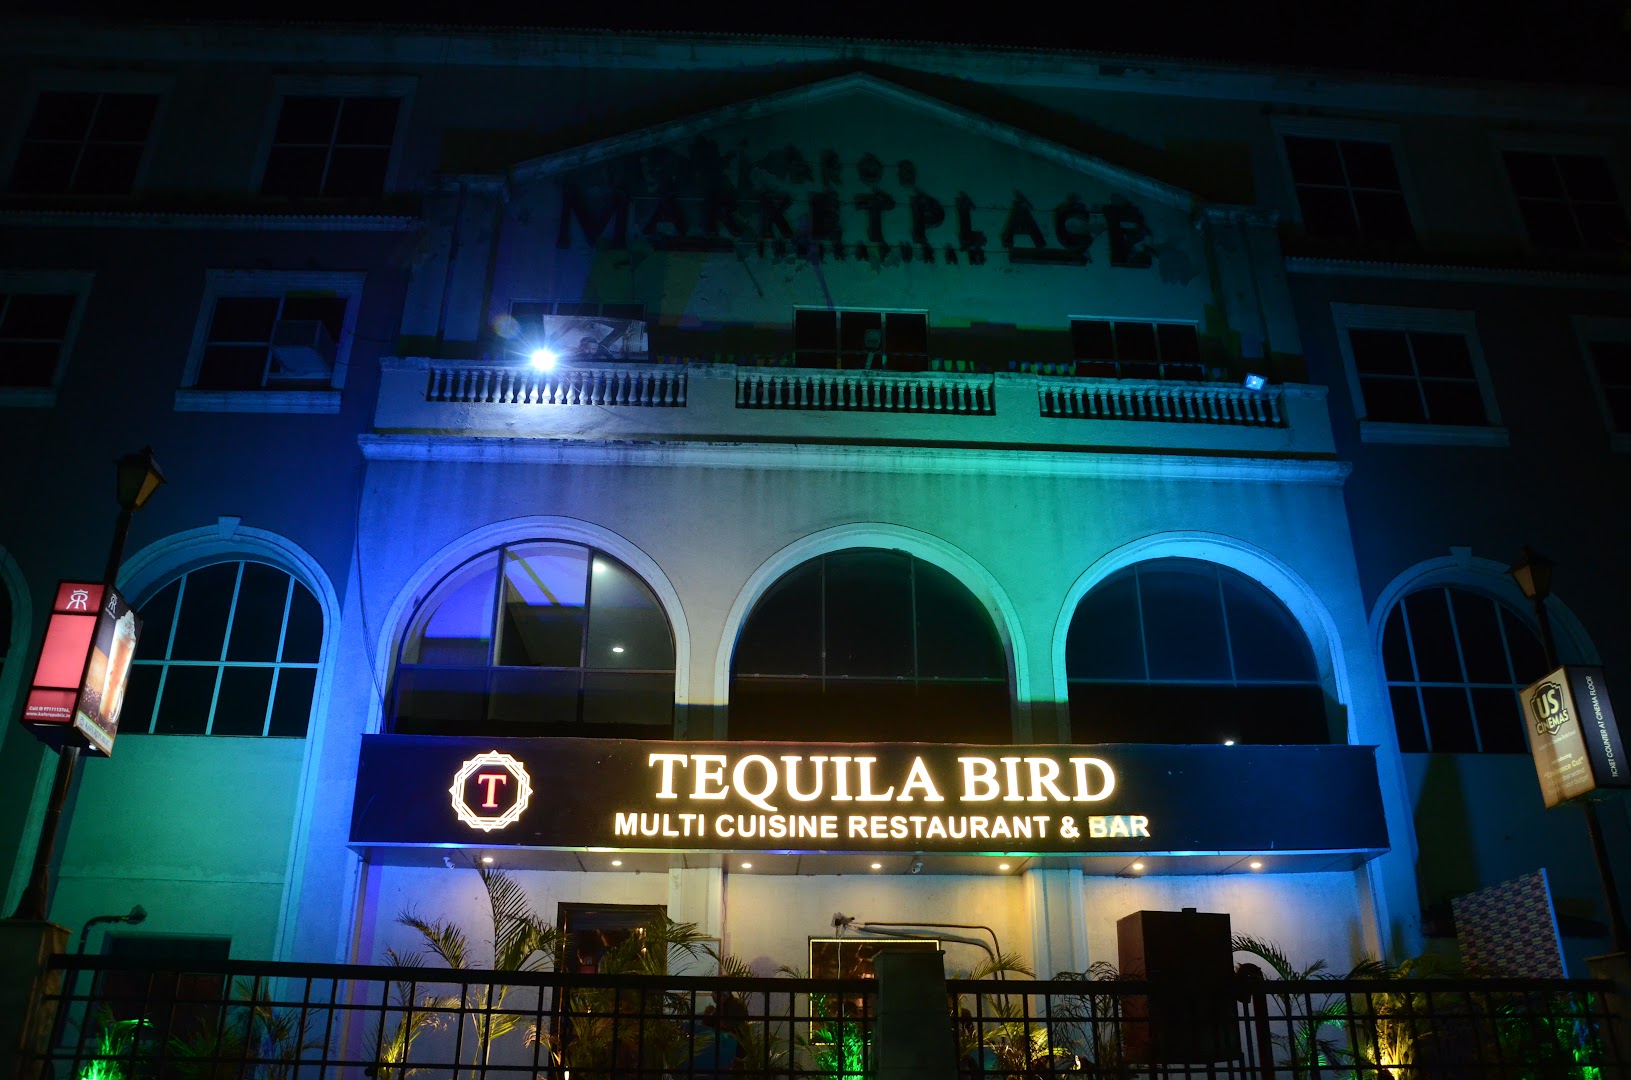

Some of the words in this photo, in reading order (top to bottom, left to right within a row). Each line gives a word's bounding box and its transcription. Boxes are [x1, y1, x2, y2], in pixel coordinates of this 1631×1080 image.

[556, 189, 1152, 268] MARKETPLACE
[1586, 675, 1596, 696] FLOOR
[1537, 689, 1559, 718] US
[1591, 696, 1603, 720] CINEMA
[1536, 709, 1569, 733] CINEMAS
[1597, 720, 1605, 729] AT
[1600, 729, 1613, 758] COUNTER
[1608, 758, 1618, 777] TICKET
[478, 774, 507, 807] T
[649, 753, 944, 811] TEQUILA
[957, 757, 1115, 802] BIRD
[614, 812, 705, 837] MULTI
[715, 814, 838, 838] CUISINE
[848, 815, 1050, 839] RESTAURANT
[1059, 815, 1081, 838] &
[1088, 815, 1151, 838] BAR
